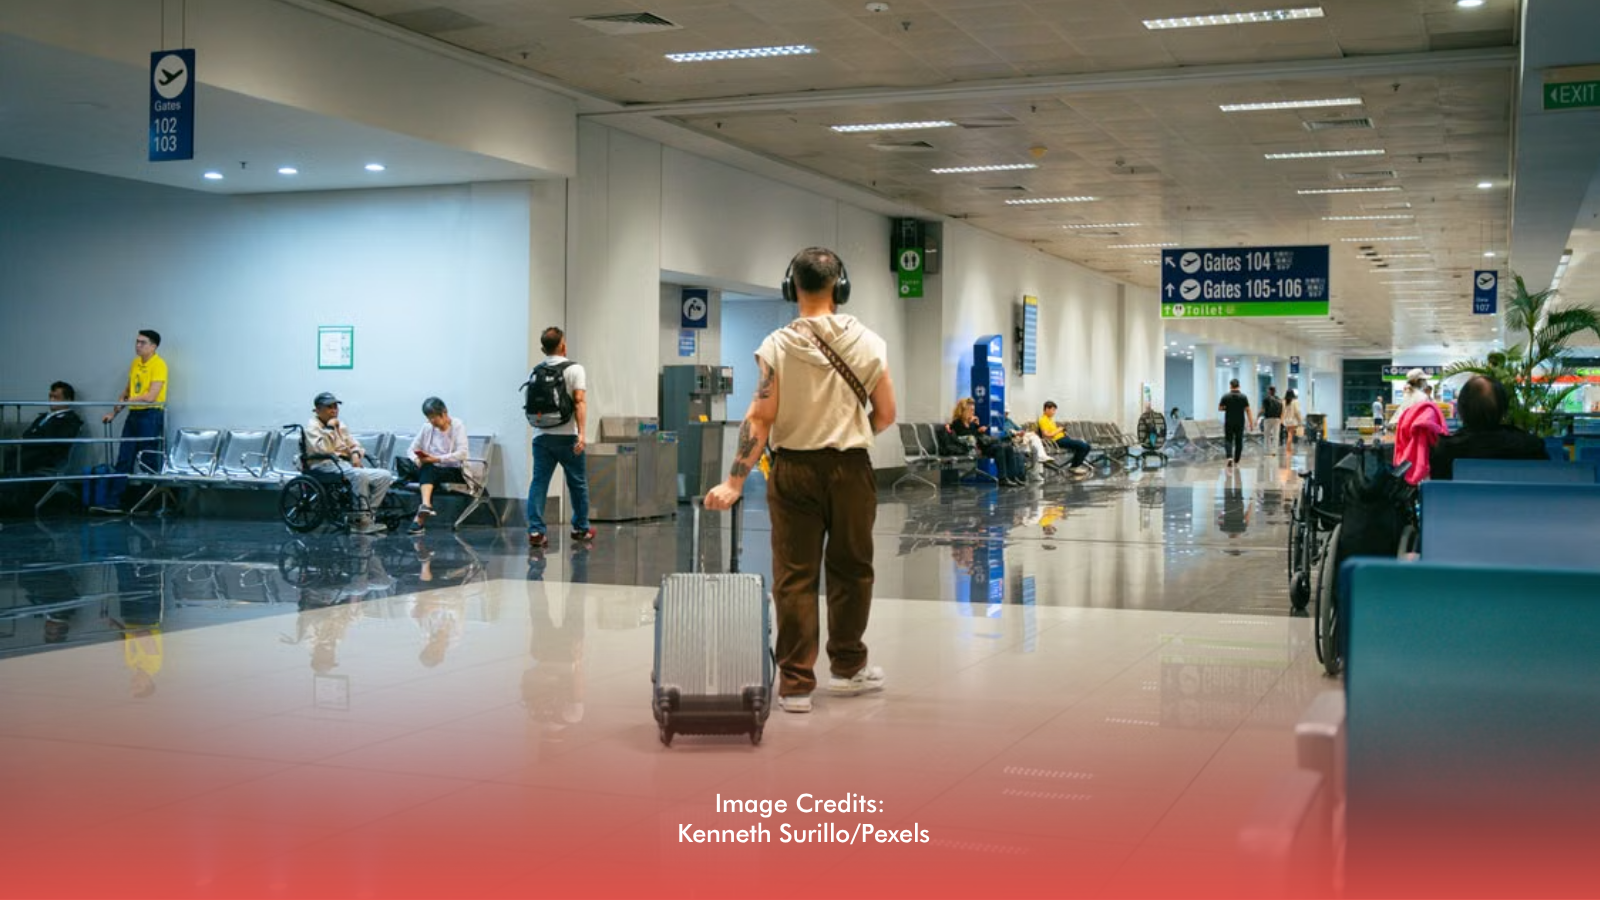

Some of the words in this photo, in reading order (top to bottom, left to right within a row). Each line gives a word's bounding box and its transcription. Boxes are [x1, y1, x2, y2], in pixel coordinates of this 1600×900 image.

[1559, 83, 1598, 104] EXIT
[154, 100, 182, 112] Gates
[154, 117, 178, 134] 102
[154, 135, 178, 152] 103
[1203, 252, 1242, 272] Gates
[1245, 251, 1271, 272] 104
[1203, 279, 1242, 299] Gates
[1245, 277, 1302, 299] 105-106
[1185, 304, 1223, 315] Toilet
[1476, 304, 1490, 312] 107
